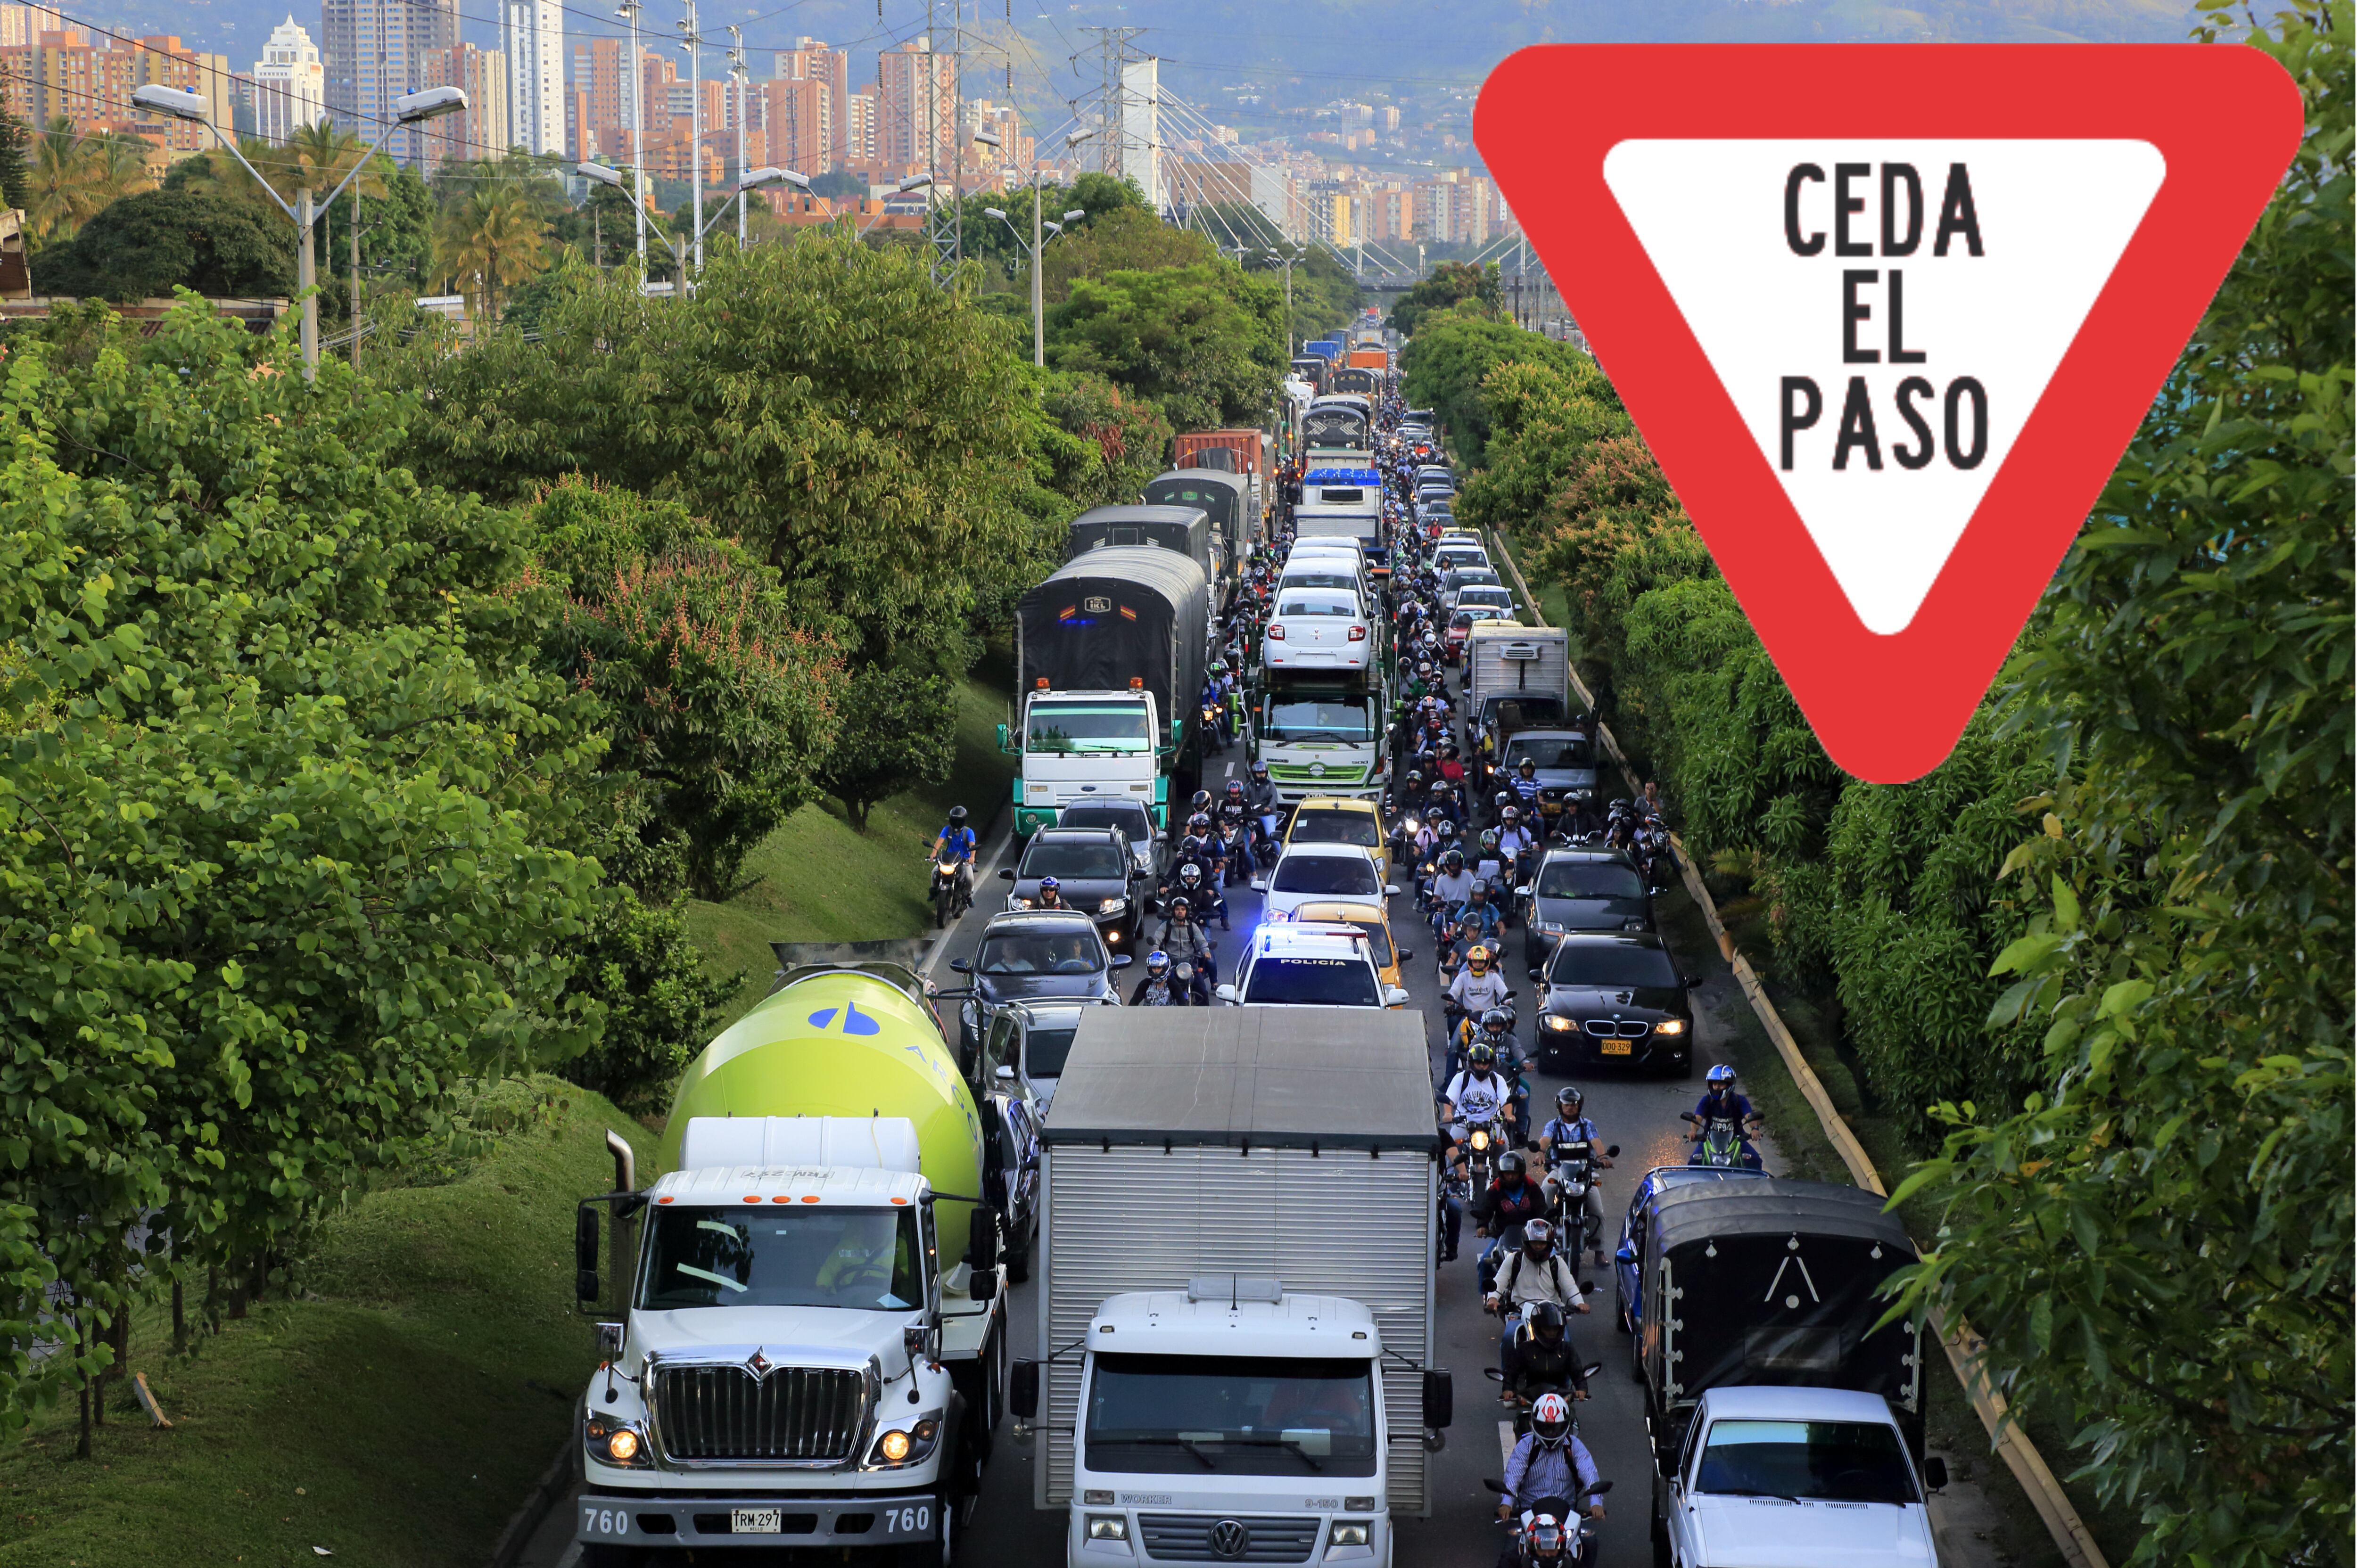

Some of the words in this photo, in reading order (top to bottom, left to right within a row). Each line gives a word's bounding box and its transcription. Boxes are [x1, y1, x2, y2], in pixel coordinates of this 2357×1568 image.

[1121, 1494, 1172, 1504] WORKER
[1305, 1499, 1339, 1508] 9-150
[585, 1508, 628, 1535] 760
[886, 1506, 929, 1533] 760
